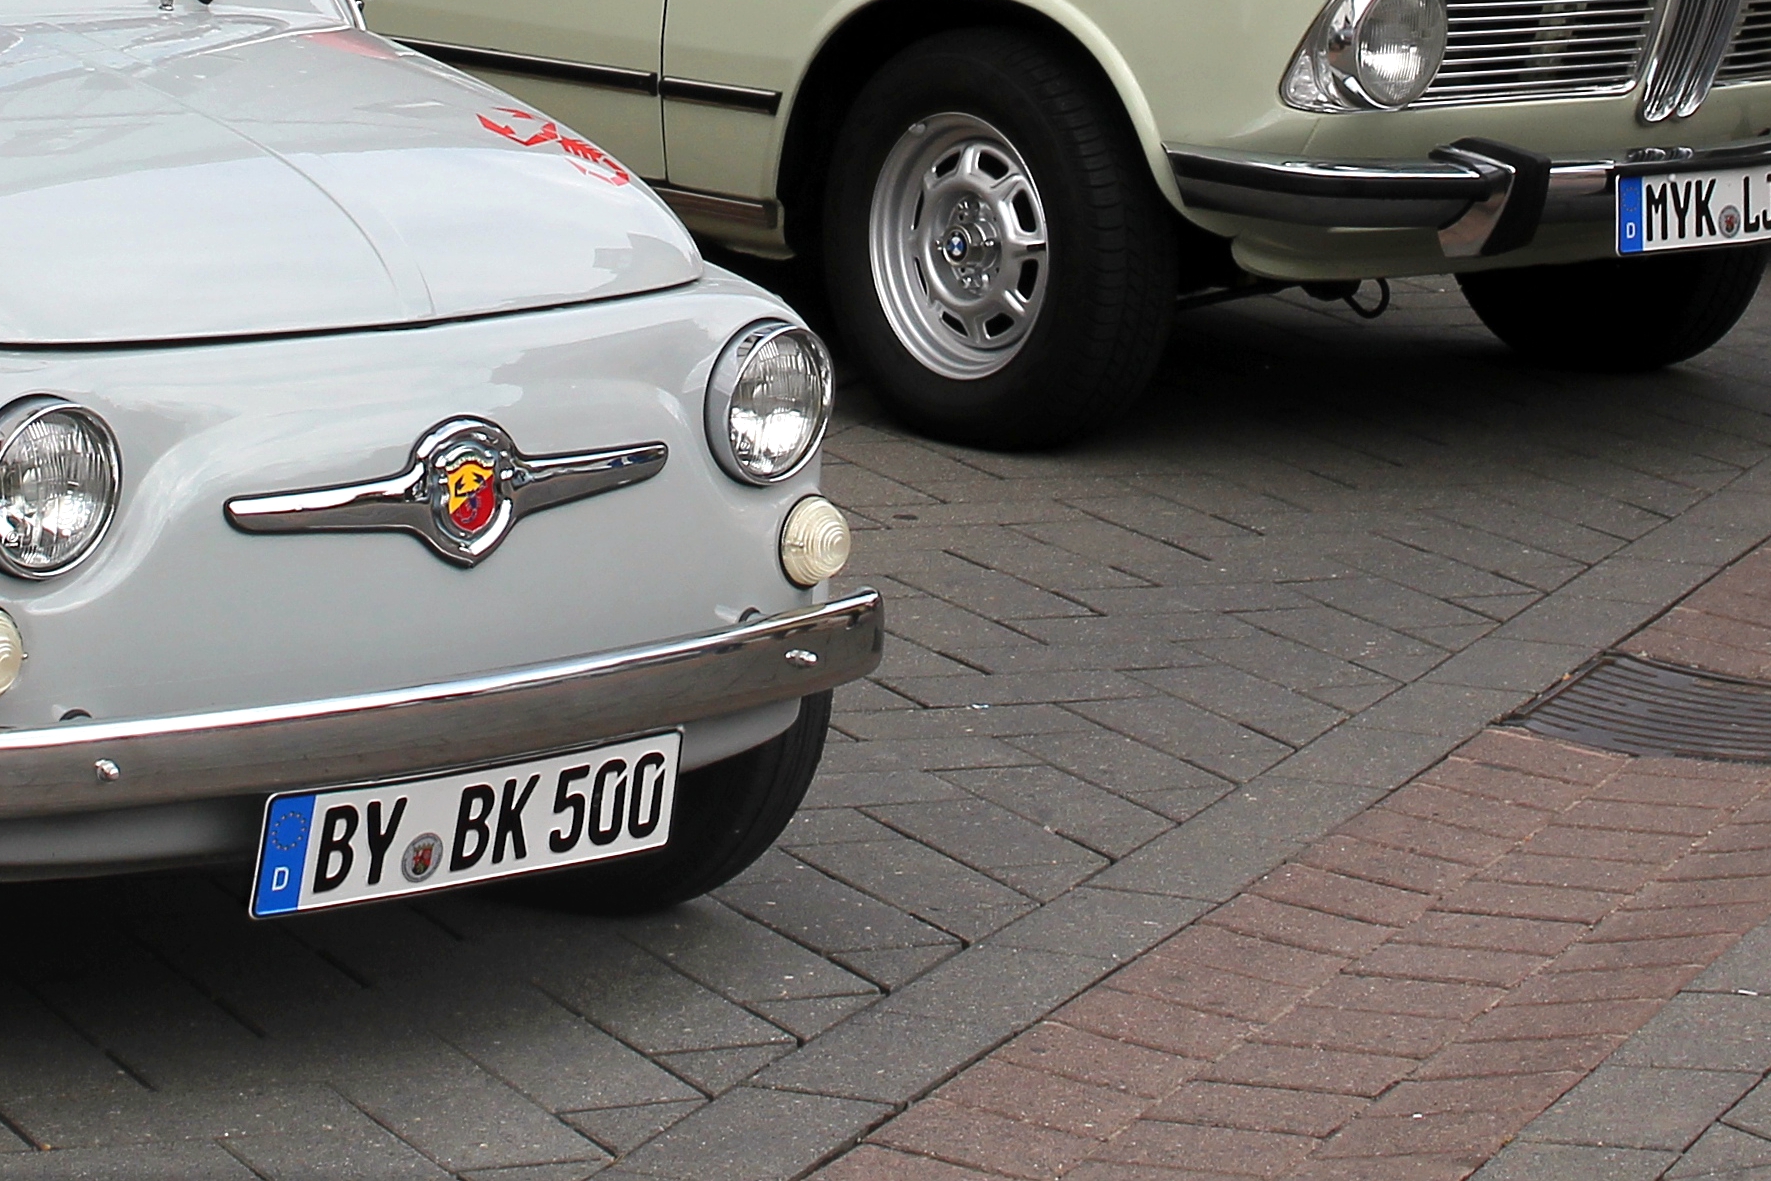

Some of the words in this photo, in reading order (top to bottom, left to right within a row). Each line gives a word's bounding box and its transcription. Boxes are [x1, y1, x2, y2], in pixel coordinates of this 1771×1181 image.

[1626, 221, 1636, 239] D
[1645, 178, 1717, 242] MYK
[271, 866, 290, 892] D
[312, 796, 409, 894] BY
[448, 773, 541, 873] BK
[548, 751, 666, 854] 500
